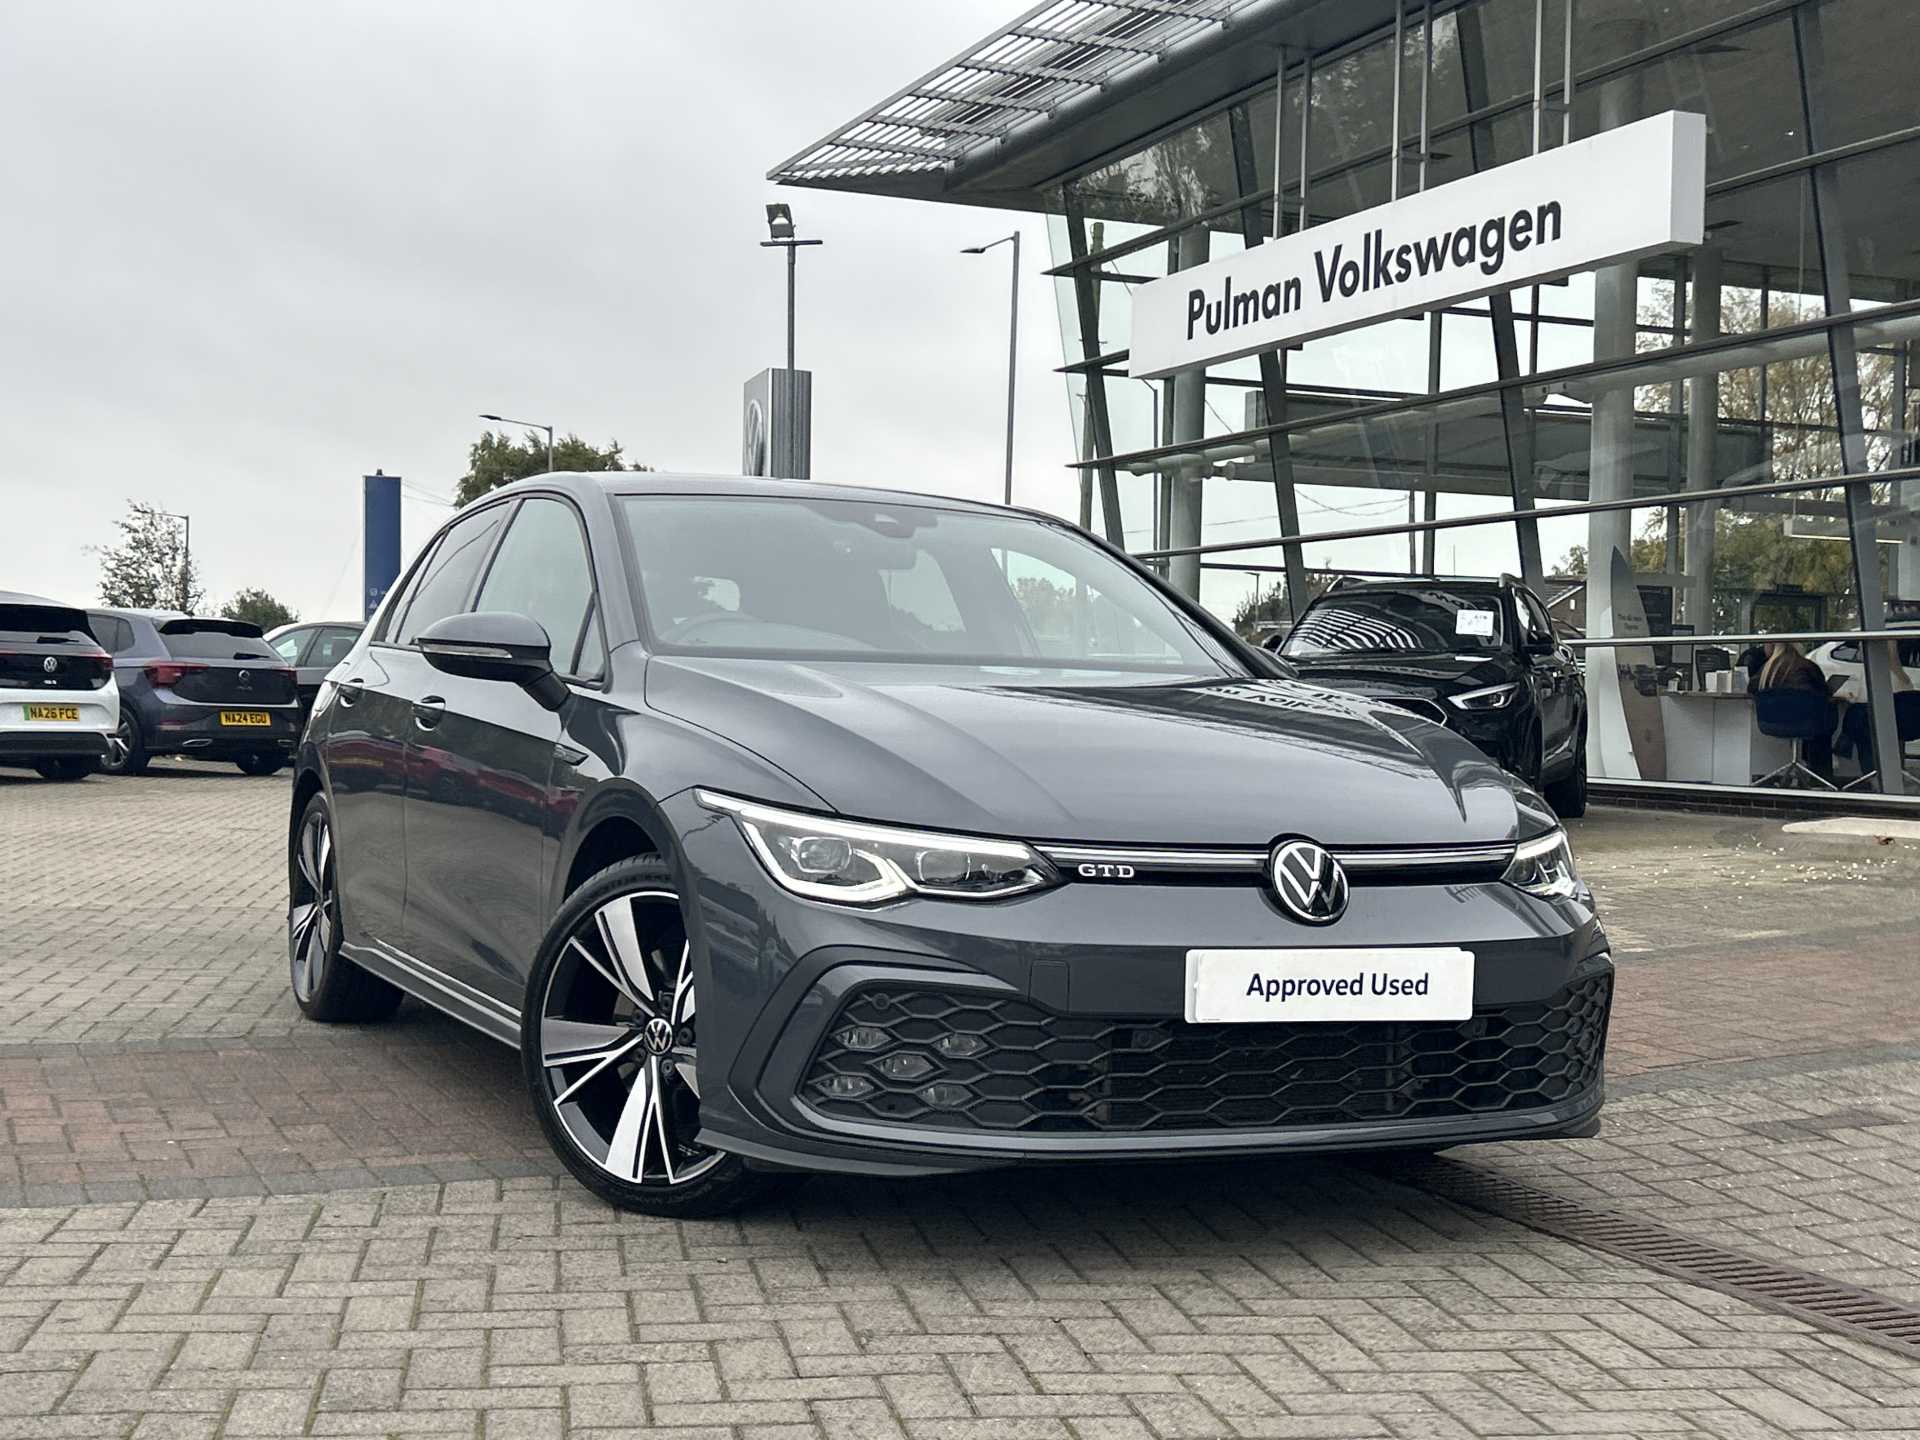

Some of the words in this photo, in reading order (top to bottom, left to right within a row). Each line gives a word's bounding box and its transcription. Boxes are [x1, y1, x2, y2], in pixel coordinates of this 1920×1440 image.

[1187, 275, 1302, 341] Pulman
[1313, 200, 1562, 304] Volkswagen
[1078, 863, 1135, 878] GTD
[1246, 972, 1364, 1003] Approved
[1371, 972, 1429, 996] Used
